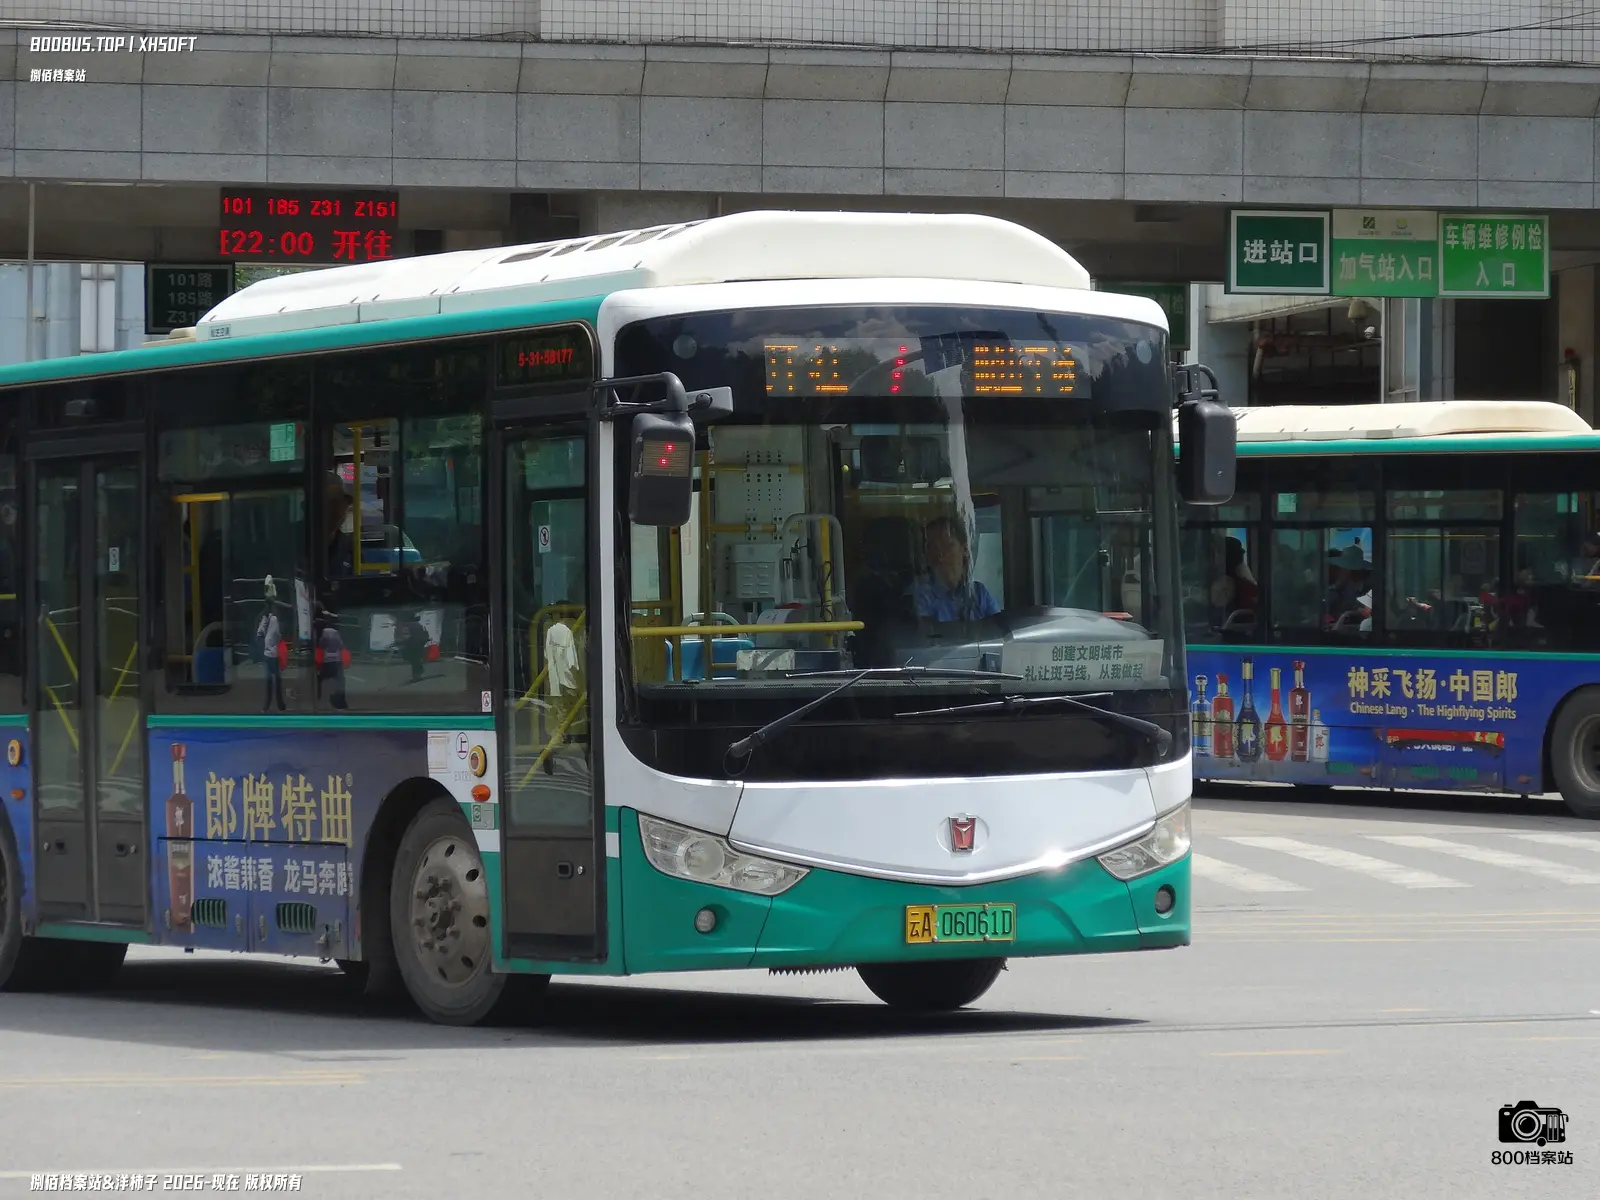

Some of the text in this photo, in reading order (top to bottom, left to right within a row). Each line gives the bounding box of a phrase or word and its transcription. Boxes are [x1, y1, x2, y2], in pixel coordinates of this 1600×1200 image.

[223, 197, 396, 217] 101 185 Z31 Z151
[332, 229, 393, 260] 开往
[1445, 223, 1542, 250] 车辆维修例检
[1243, 238, 1318, 265] 进站口
[168, 272, 213, 288] 101路
[1340, 251, 1432, 282] 加气站入口
[1475, 260, 1516, 288] 入口
[168, 291, 213, 307] 185路
[1051, 644, 1124, 662] 创建文明城市
[1350, 702, 1384, 714] Chinese
[1386, 703, 1408, 719] Lang
[1418, 704, 1435, 716] The
[1437, 705, 1485, 721] Highflying
[1487, 706, 1517, 721] Spirits
[205, 771, 353, 848] 郎牌特曲
[207, 855, 274, 892] 浓酱兼香
[909, 909, 1013, 937] 云A 06061D
